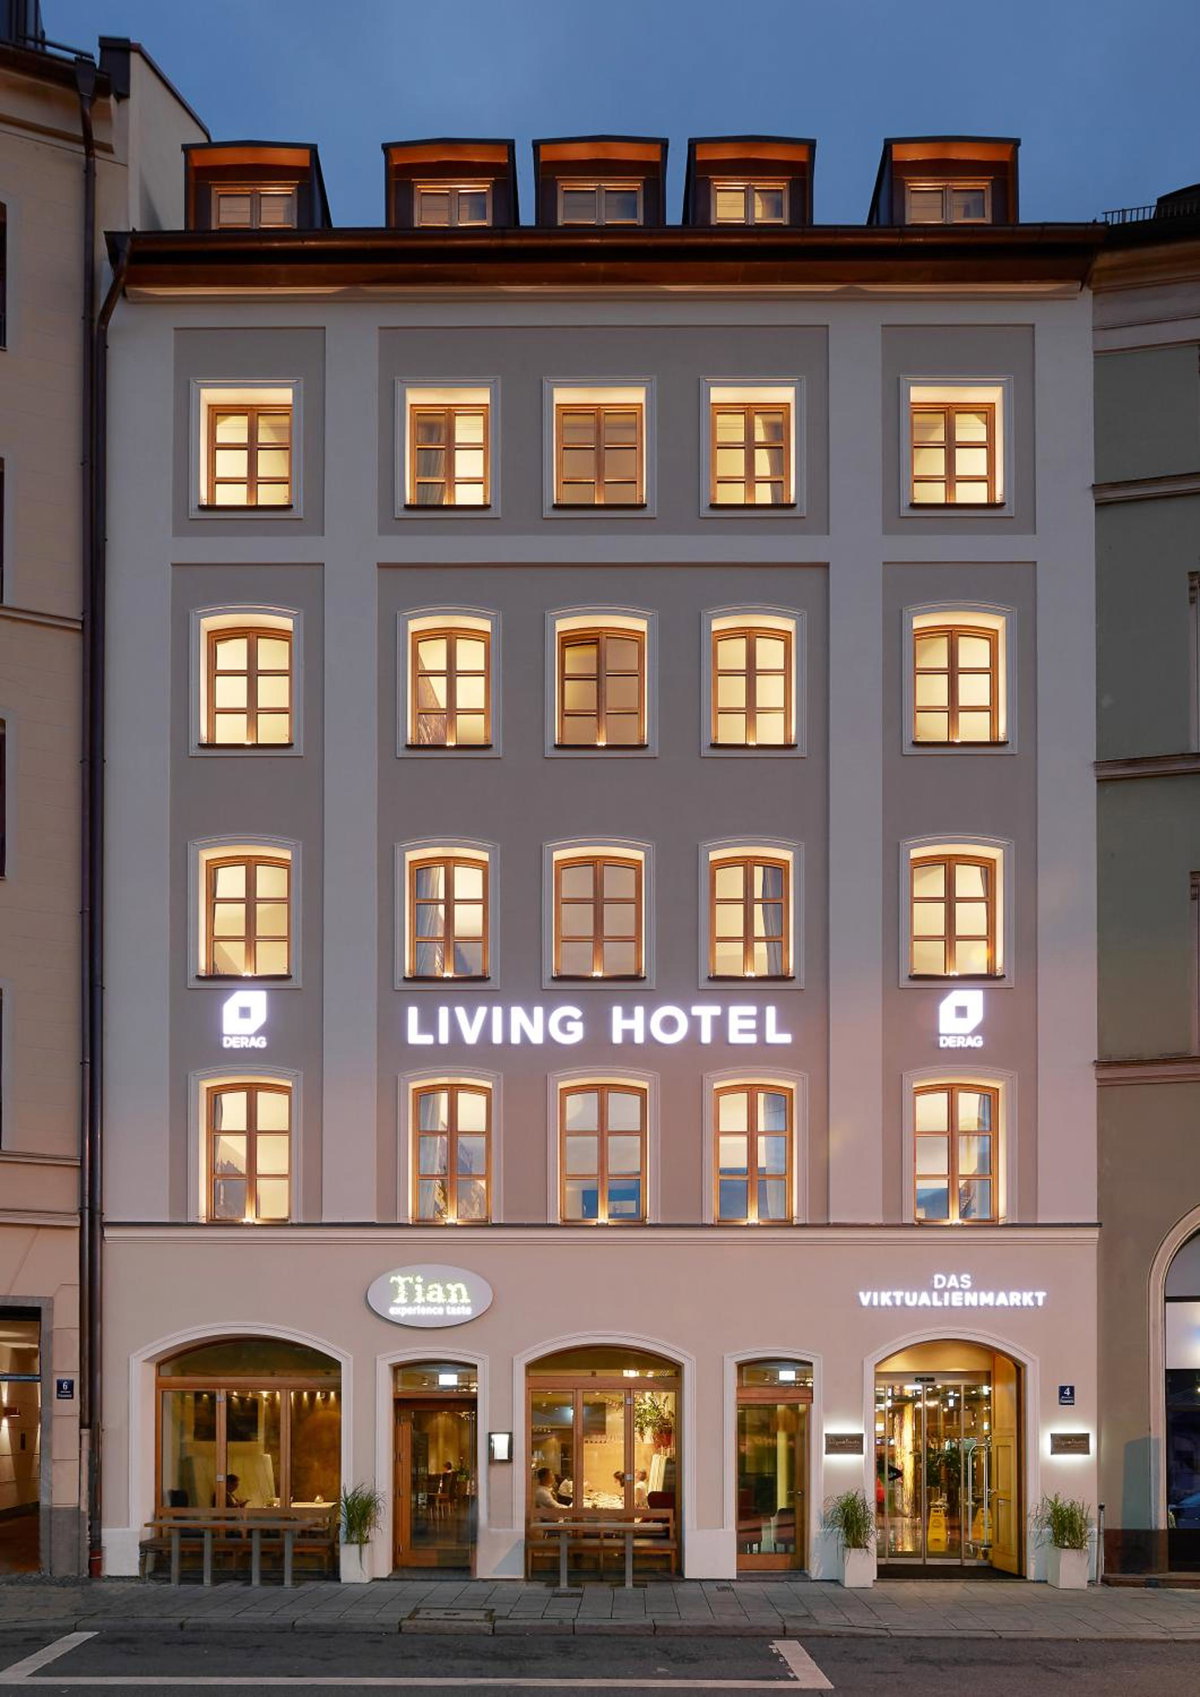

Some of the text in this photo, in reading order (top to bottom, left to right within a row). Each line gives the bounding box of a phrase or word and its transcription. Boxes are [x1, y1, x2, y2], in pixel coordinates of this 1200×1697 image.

[407, 1005, 793, 1045] LIVING HOTEL
[222, 1036, 267, 1049] DERAG
[939, 1035, 984, 1049] DERAG
[933, 1273, 972, 1289] DAS
[389, 1275, 472, 1304] Tian
[858, 1291, 1047, 1307] VIKTUALIENMARKT
[388, 1305, 444, 1317] experience
[62, 1381, 68, 1390] 6
[1063, 1387, 1071, 1396] 4
